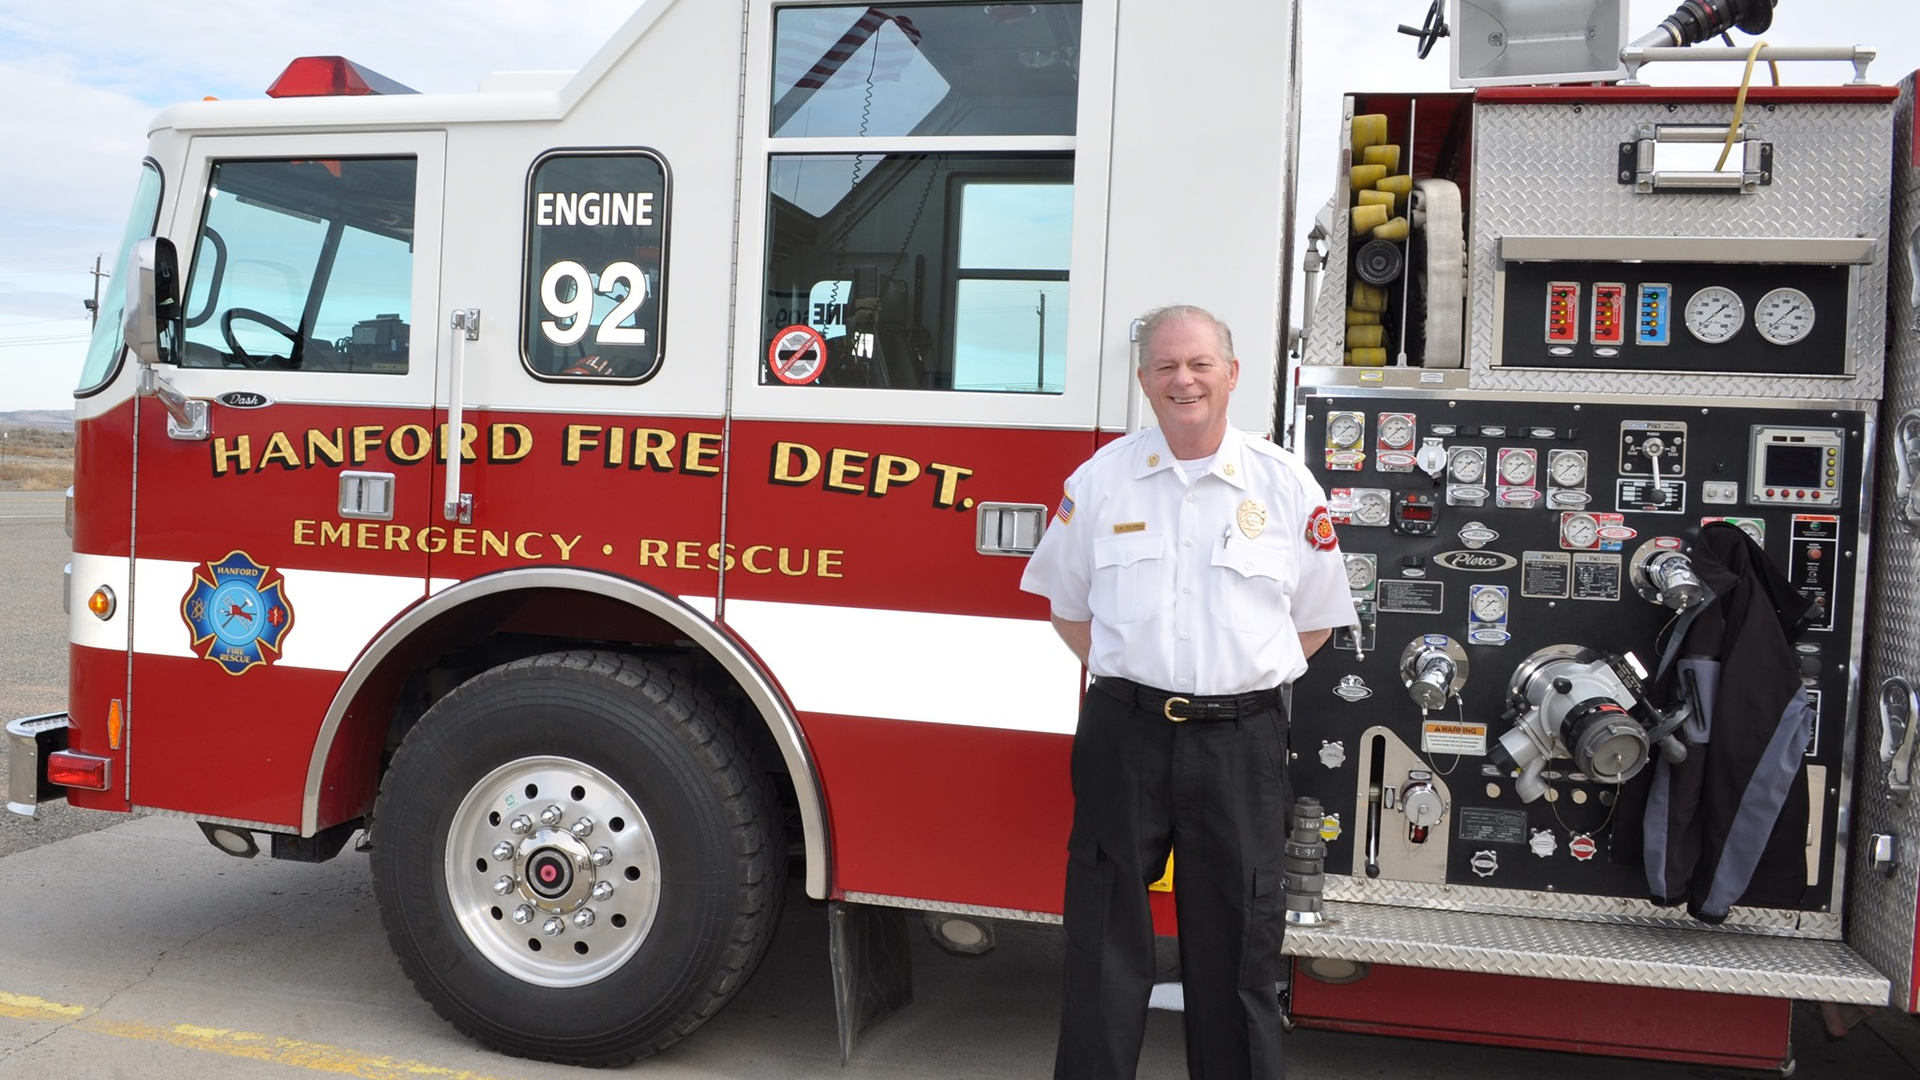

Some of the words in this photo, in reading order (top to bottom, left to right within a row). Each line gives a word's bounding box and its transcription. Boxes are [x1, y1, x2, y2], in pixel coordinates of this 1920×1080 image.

[536, 192, 654, 226] ENGINE
[541, 260, 646, 345] 92
[229, 393, 259, 405] Dash
[212, 423, 534, 476] HANFORD
[562, 424, 722, 476] FIRE
[769, 441, 974, 509] DEPT.
[292, 518, 583, 561] EMERGENCY
[637, 538, 845, 579] RESCUE
[1451, 552, 1498, 568] Pierce
[217, 566, 259, 577] HANFORD
[219, 653, 251, 664] RESCUE
[226, 647, 245, 656] FIRE
[1441, 725, 1477, 735] WARNING
